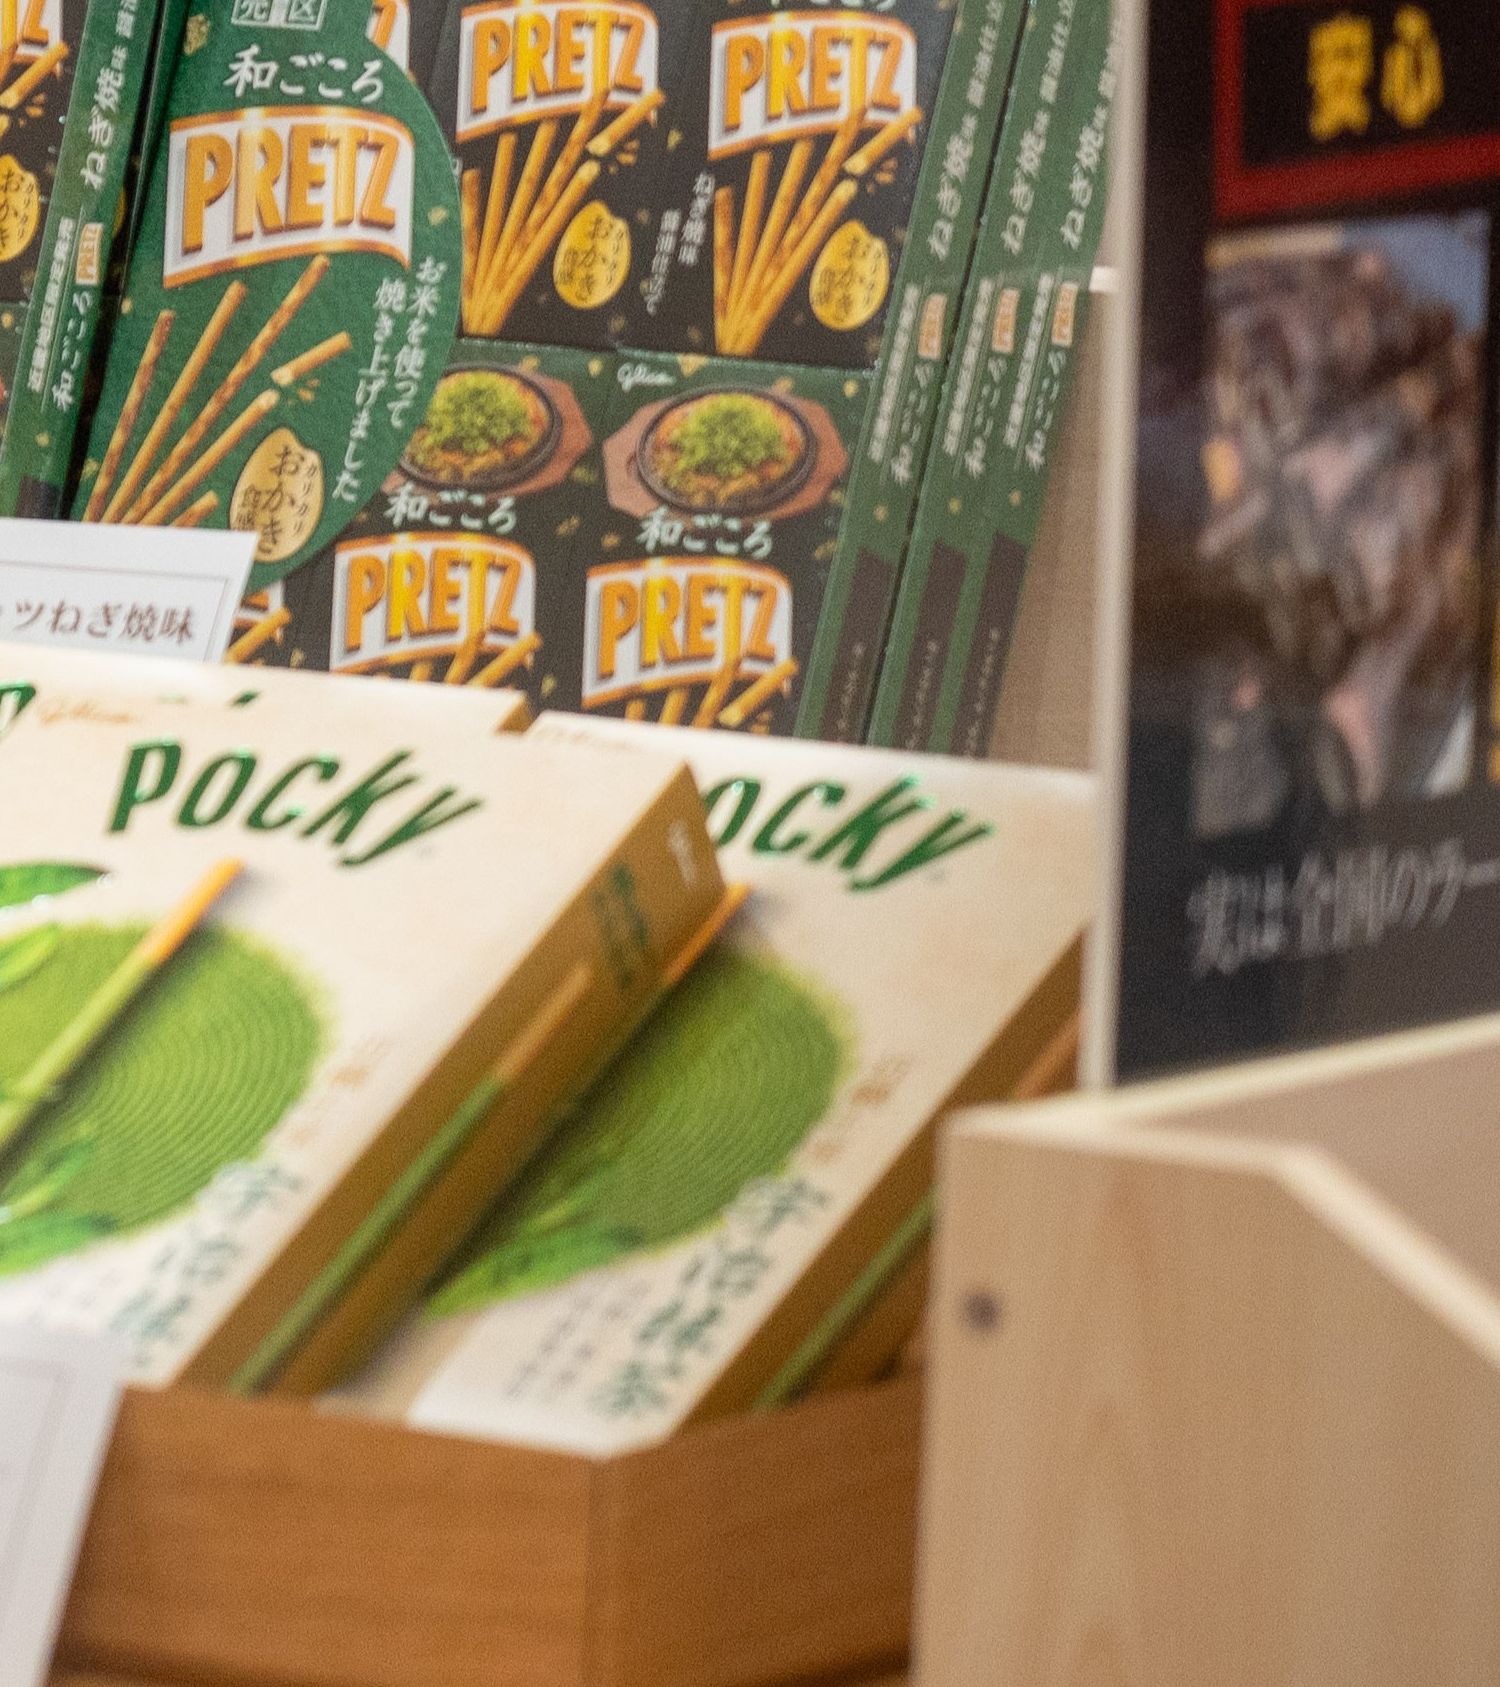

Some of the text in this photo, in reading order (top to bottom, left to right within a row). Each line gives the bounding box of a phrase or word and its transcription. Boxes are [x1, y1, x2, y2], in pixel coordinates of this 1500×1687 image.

[224, 44, 383, 102] 和ごころ
[472, 12, 644, 112] PRETZ
[726, 27, 903, 130] PRETZ
[184, 125, 396, 253] PRETZ
[345, 549, 525, 653] PRETZ
[598, 568, 782, 677] PRETZ
[701, 773, 995, 892] OCKY
